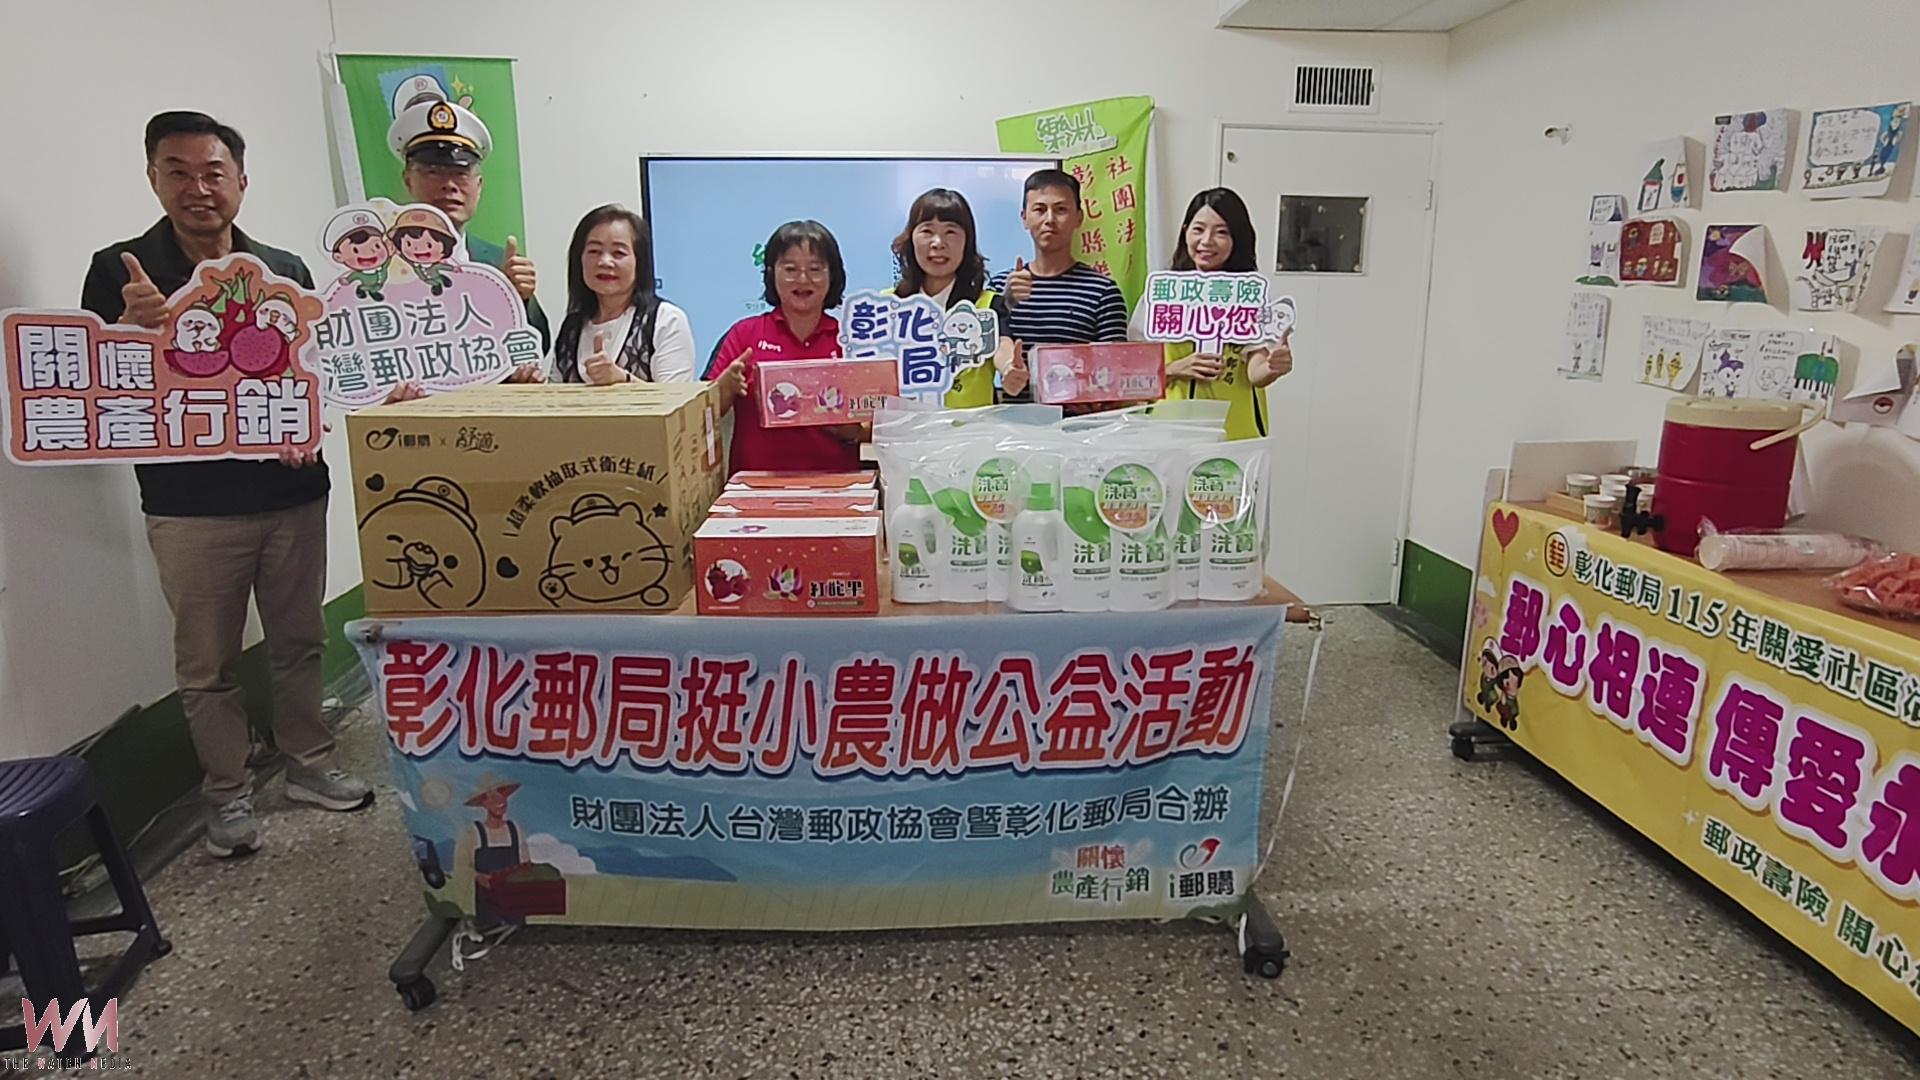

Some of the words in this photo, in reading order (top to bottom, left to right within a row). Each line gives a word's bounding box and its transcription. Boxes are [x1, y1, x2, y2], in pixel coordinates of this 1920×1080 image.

[1152, 278, 1262, 303] 郵政壽險
[315, 294, 492, 349] 財團法人
[851, 302, 934, 342] 彰化
[1151, 303, 1259, 336] 關心您
[18, 325, 154, 390] 關懷
[321, 330, 540, 393] 灣郵政協會
[856, 346, 946, 385] 局
[23, 377, 311, 450] 農產行銷
[1501, 580, 1699, 755] 郵心相連
[384, 640, 1255, 768] 彰化郵局挺小農做公益活動
[571, 785, 1229, 842] 財團法人台灣郵政協會暨彰化郵局合辦
[1052, 867, 1149, 901] 農產行銷
[1077, 844, 1126, 869] 關懷
[1169, 870, 1234, 898] i郵購
[1704, 818, 1829, 922] 郵政壽險
